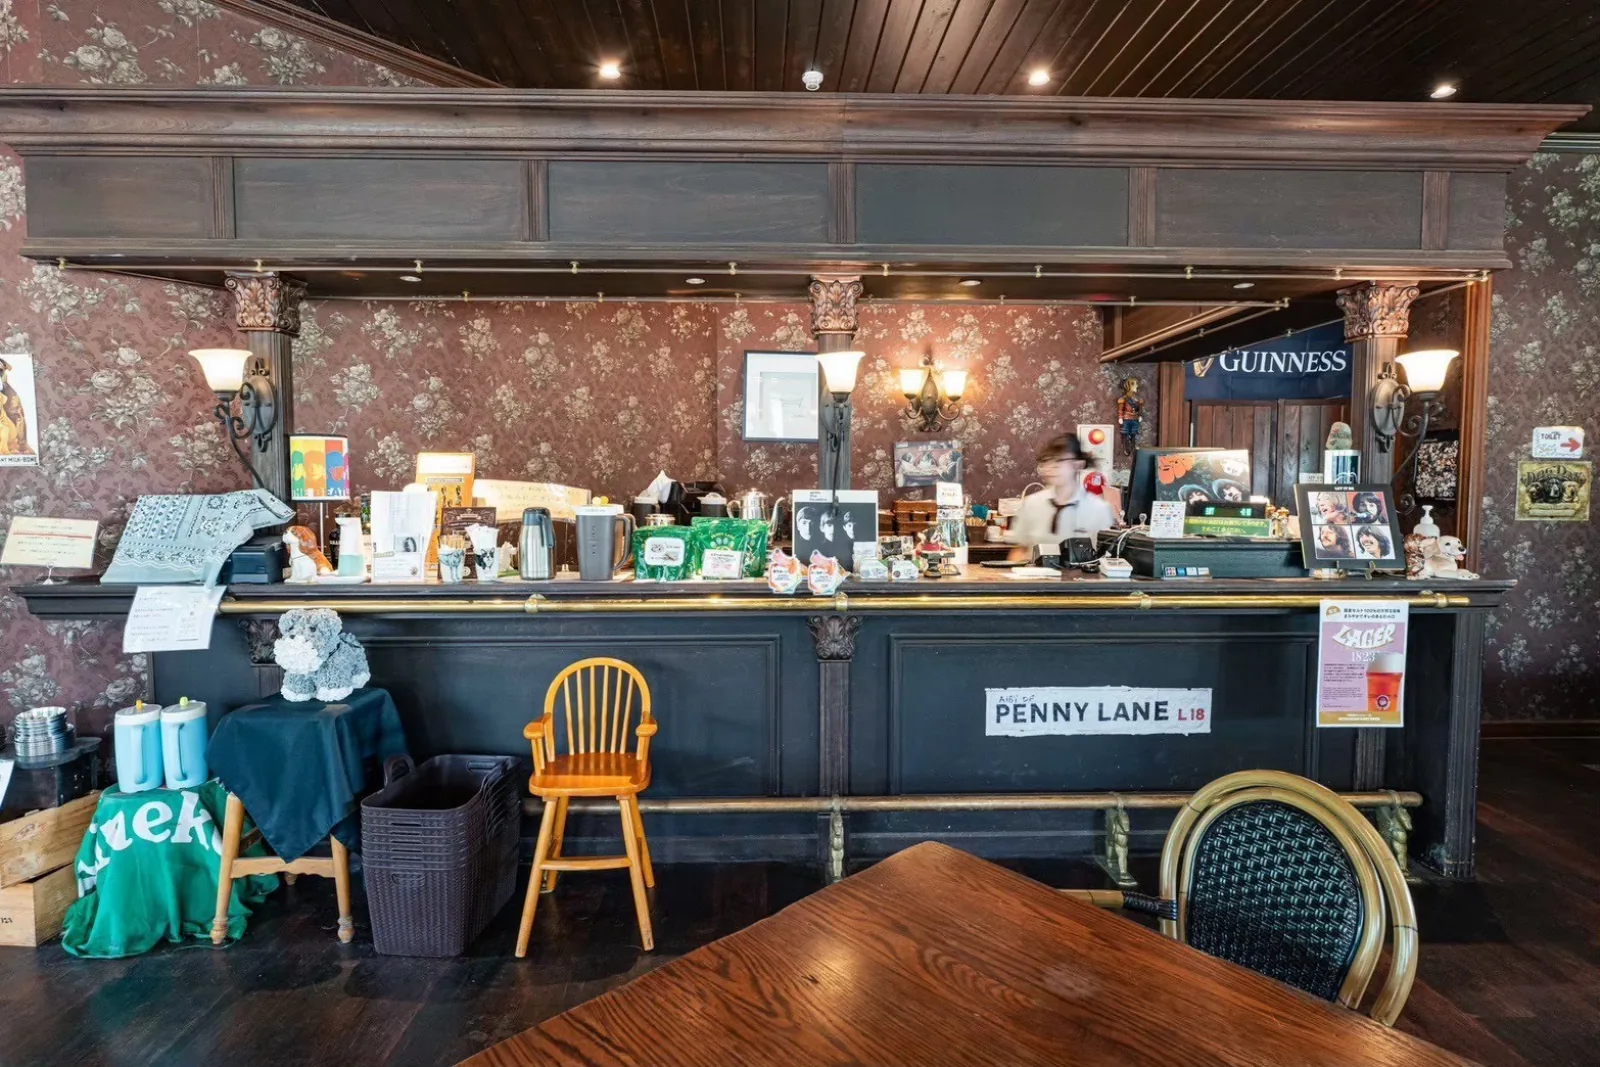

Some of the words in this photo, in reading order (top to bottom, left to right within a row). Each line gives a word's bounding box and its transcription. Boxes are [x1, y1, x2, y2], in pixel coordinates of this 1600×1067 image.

[1219, 349, 1347, 373] GUINNESS
[1332, 623, 1396, 648] LAGER
[1351, 651, 1376, 662] 1823
[995, 702, 1089, 724] PENNY
[1099, 701, 1169, 721] LANE
[1177, 708, 1205, 721] L18
